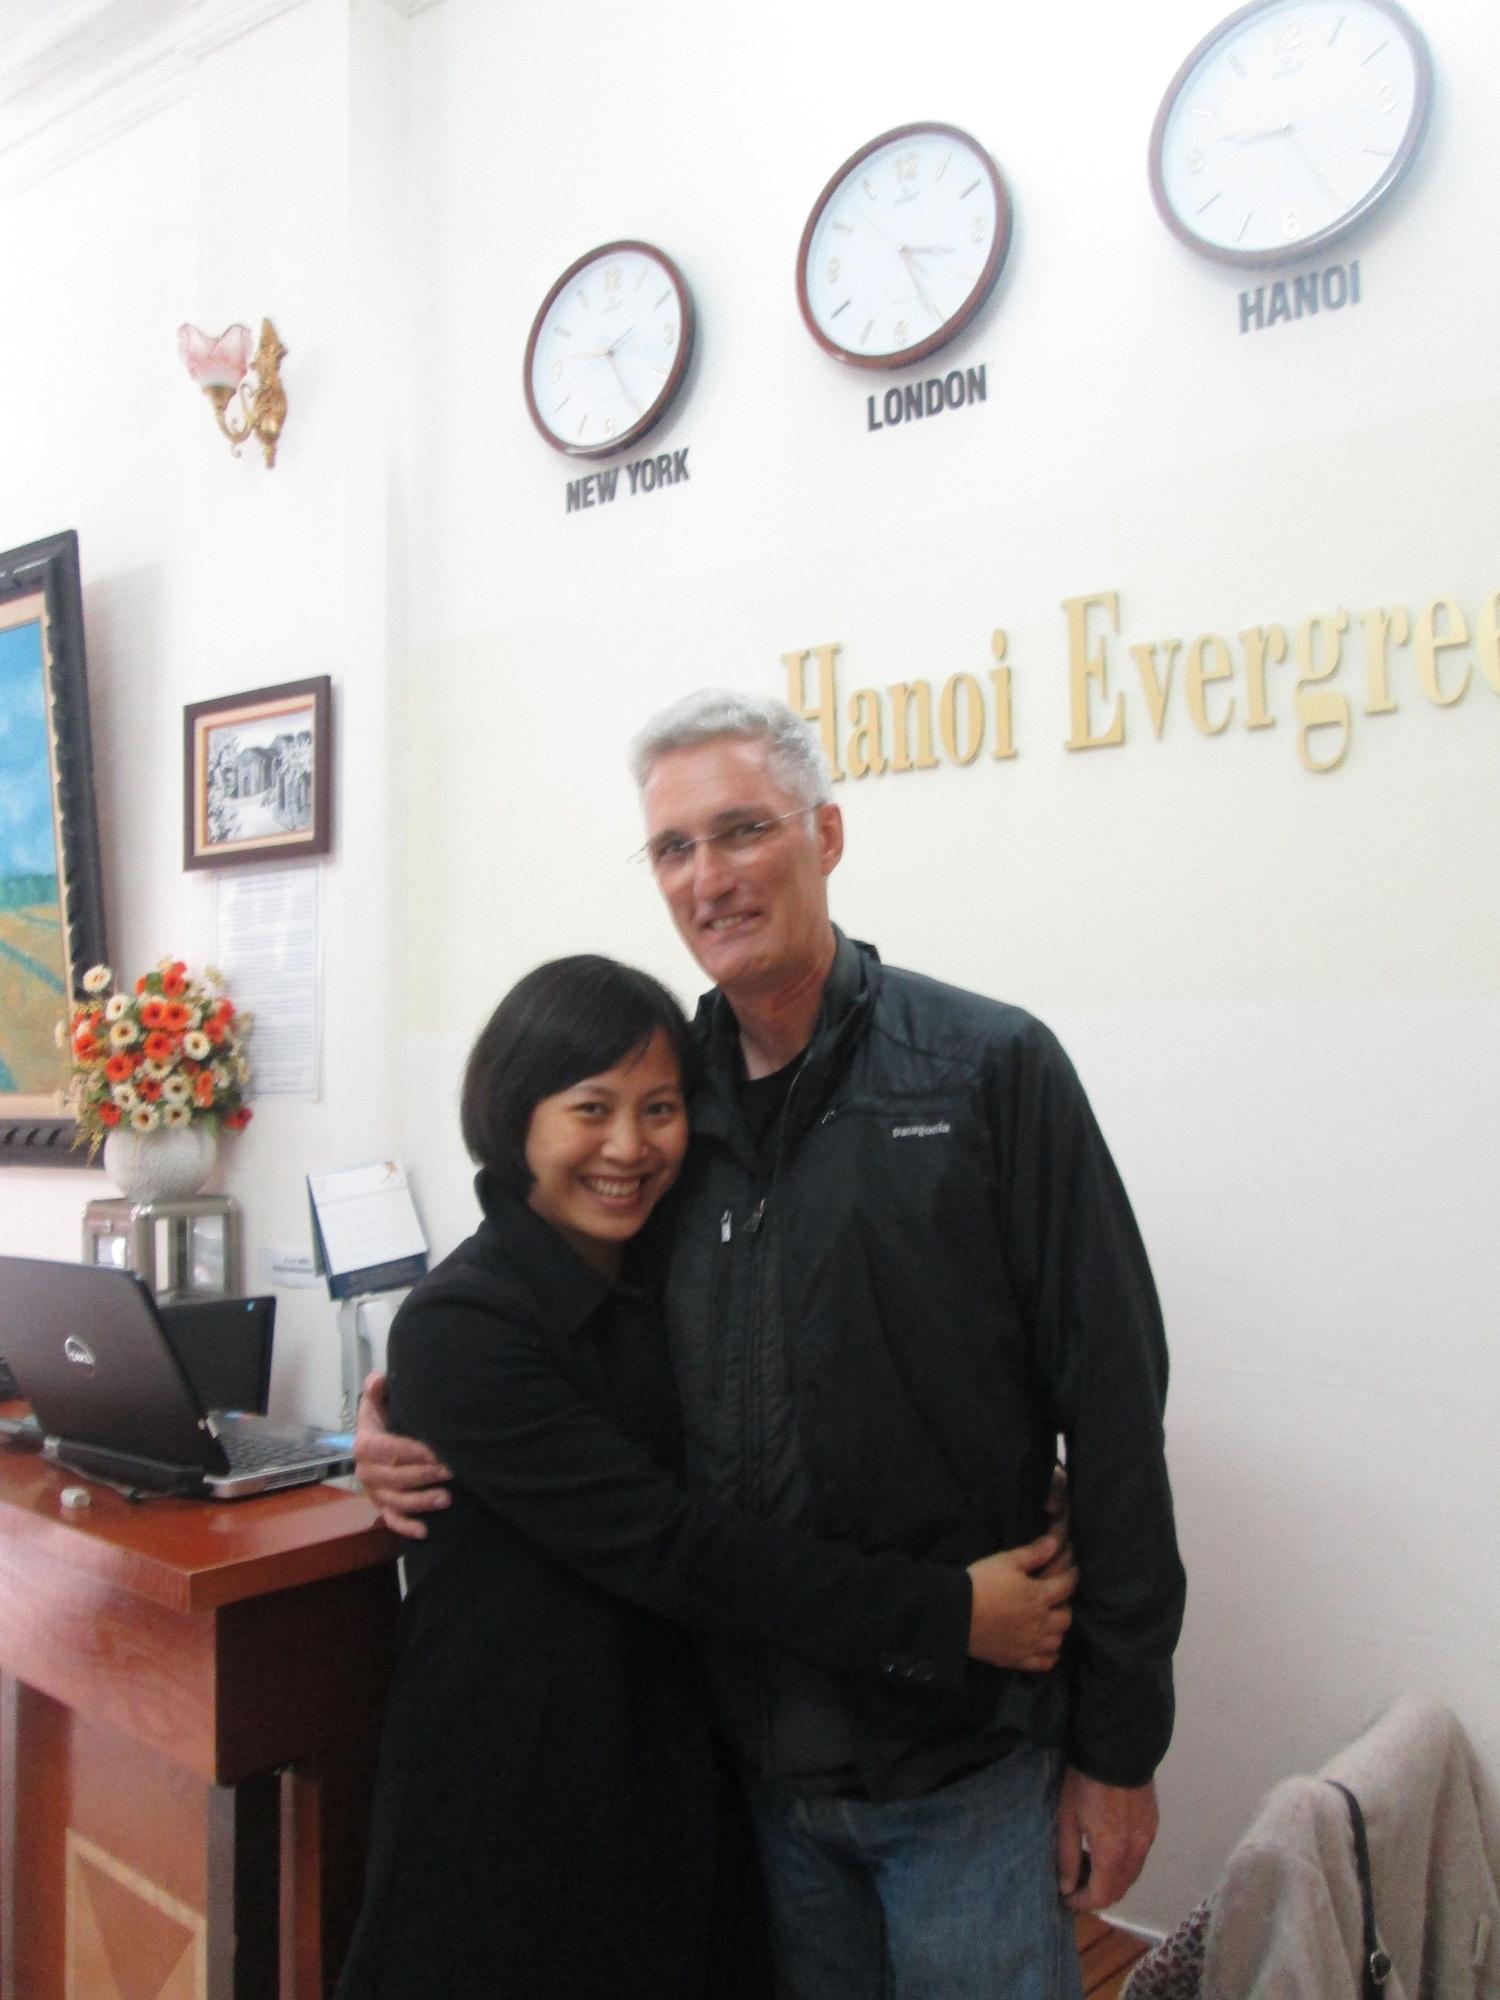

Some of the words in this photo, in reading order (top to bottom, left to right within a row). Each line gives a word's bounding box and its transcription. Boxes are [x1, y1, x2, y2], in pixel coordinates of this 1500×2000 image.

[1283, 208, 1301, 239] 6
[1237, 260, 1361, 334] HANOI
[867, 364, 988, 431] LONDON
[565, 471, 618, 514] NEW
[625, 447, 691, 497] YORK
[781, 629, 1019, 782] Hanoi
[891, 1120, 951, 1138] patagonia
